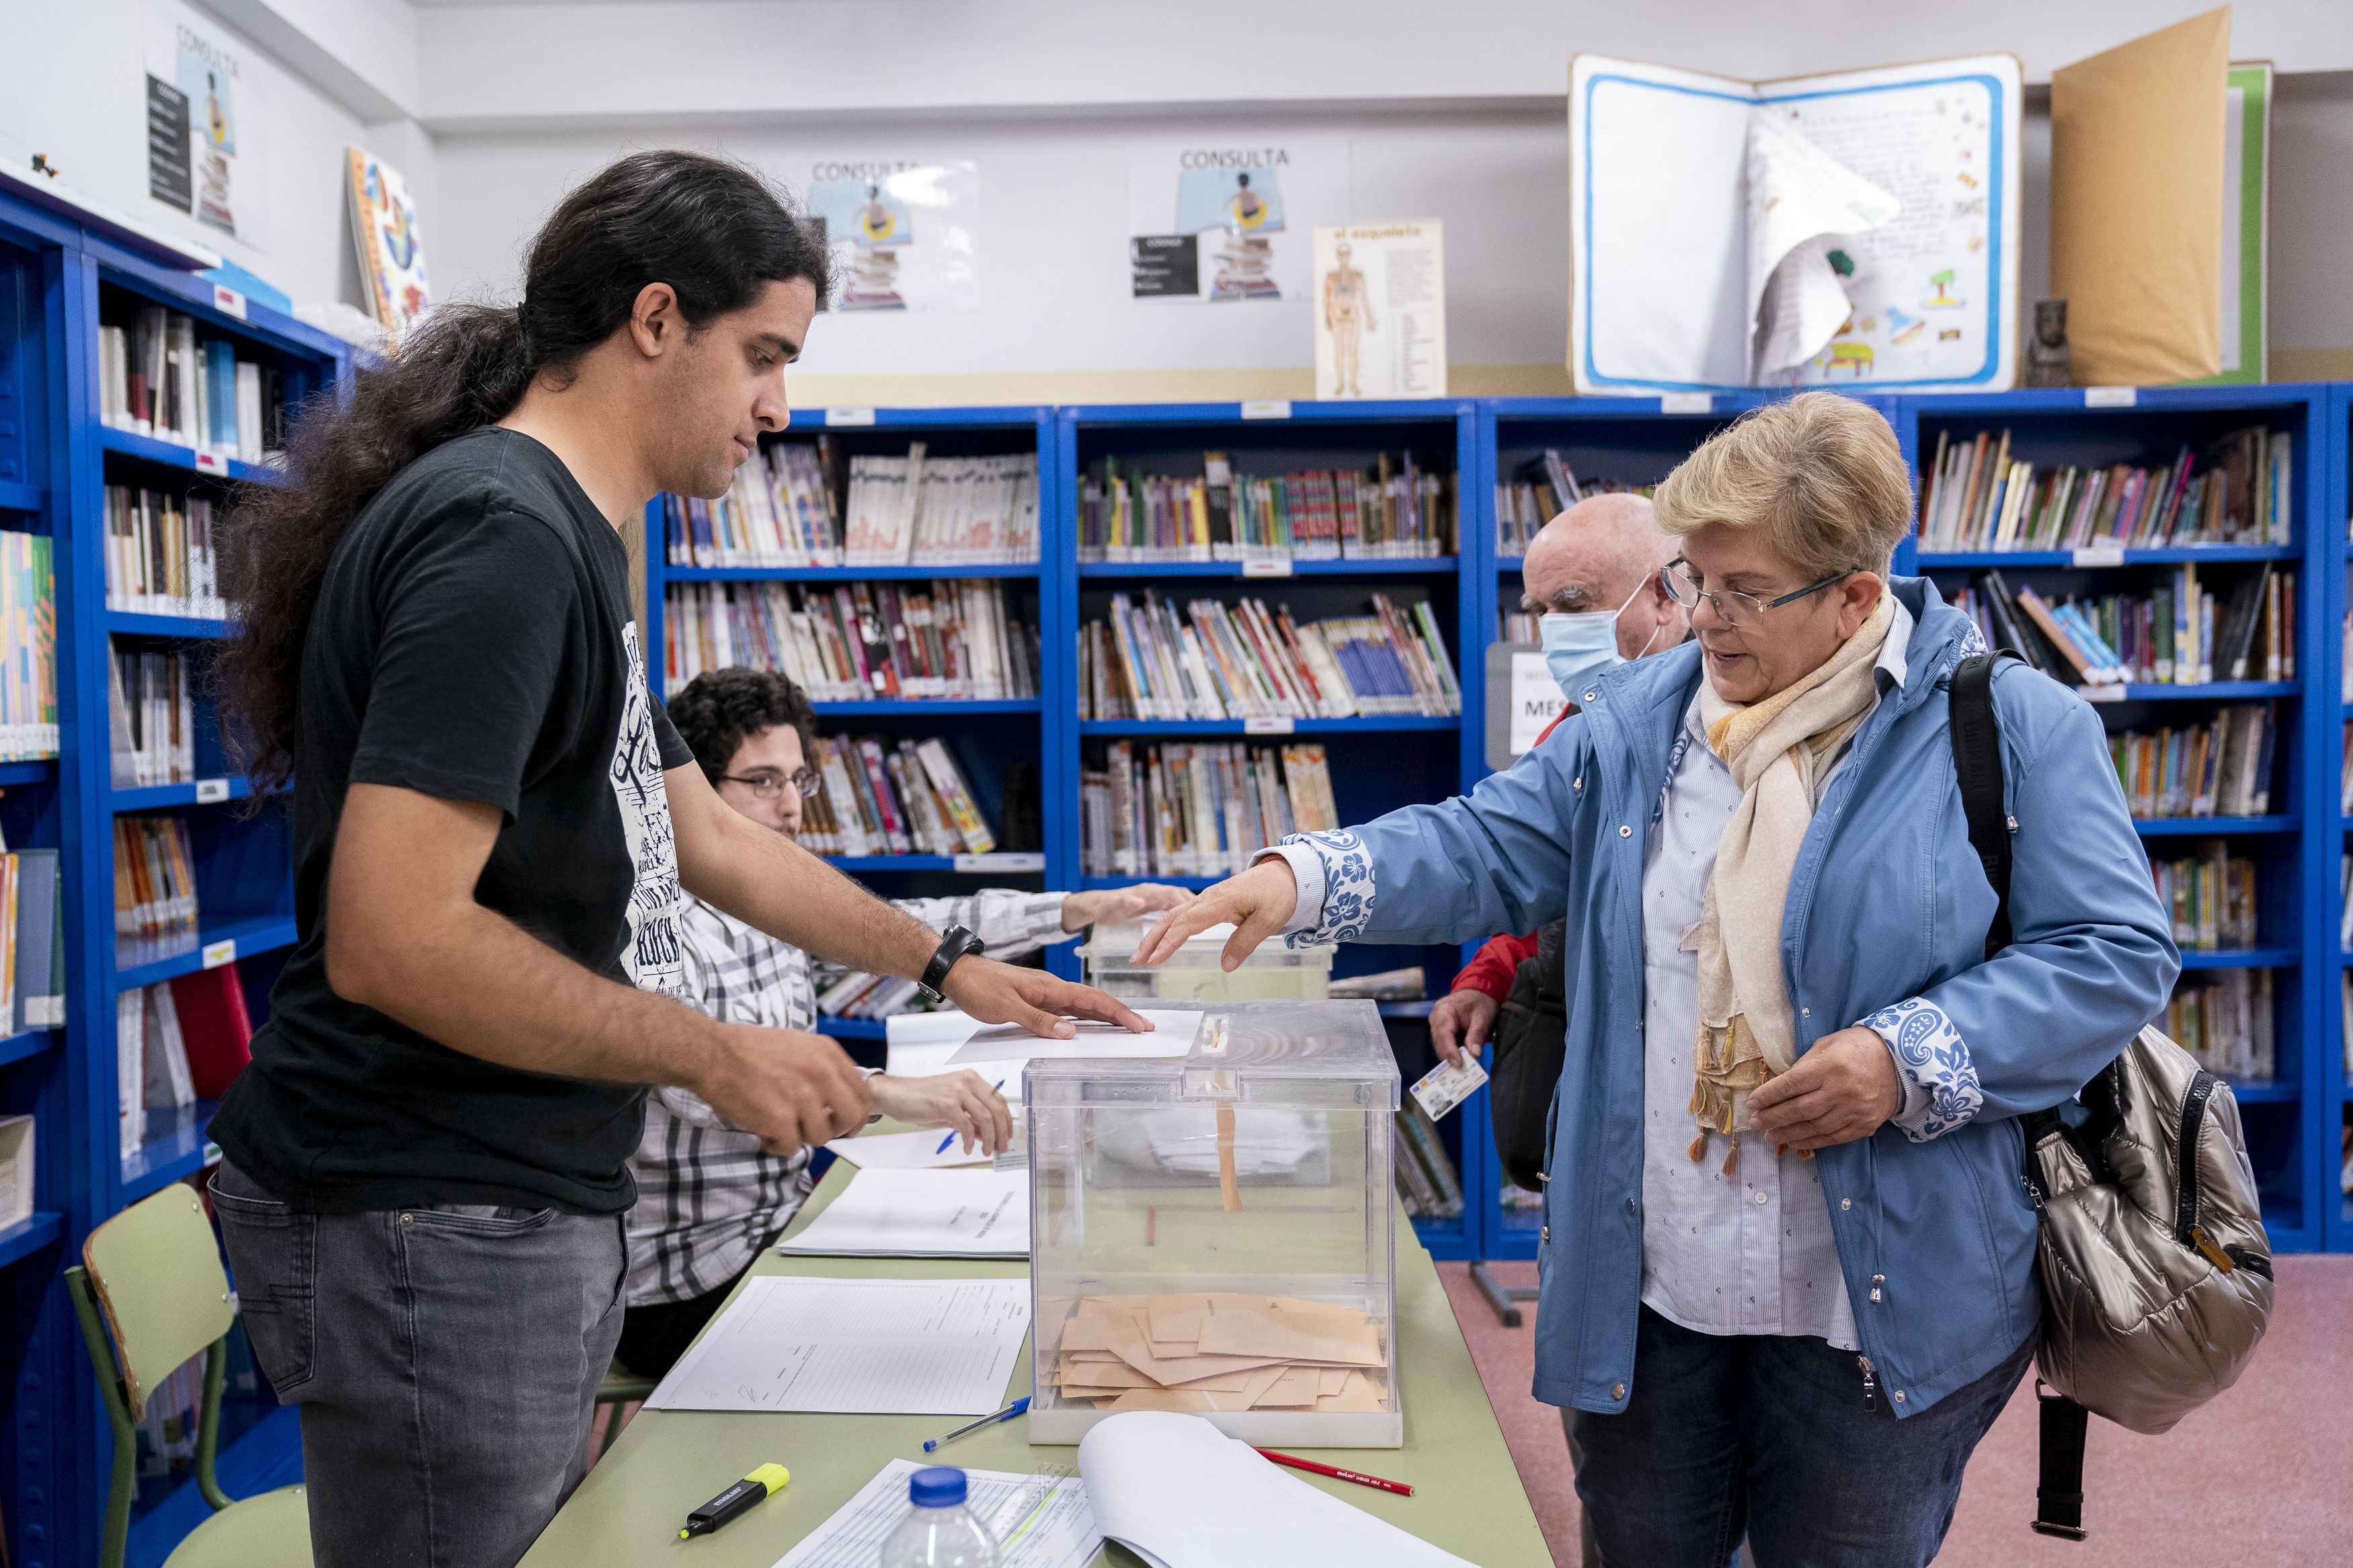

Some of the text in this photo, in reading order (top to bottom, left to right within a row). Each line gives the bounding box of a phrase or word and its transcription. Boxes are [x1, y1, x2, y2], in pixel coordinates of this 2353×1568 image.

[1180, 147, 1290, 169] CONSULTA
[1351, 226, 1421, 241] esqueleto
[637, 916, 680, 966] ROCK
